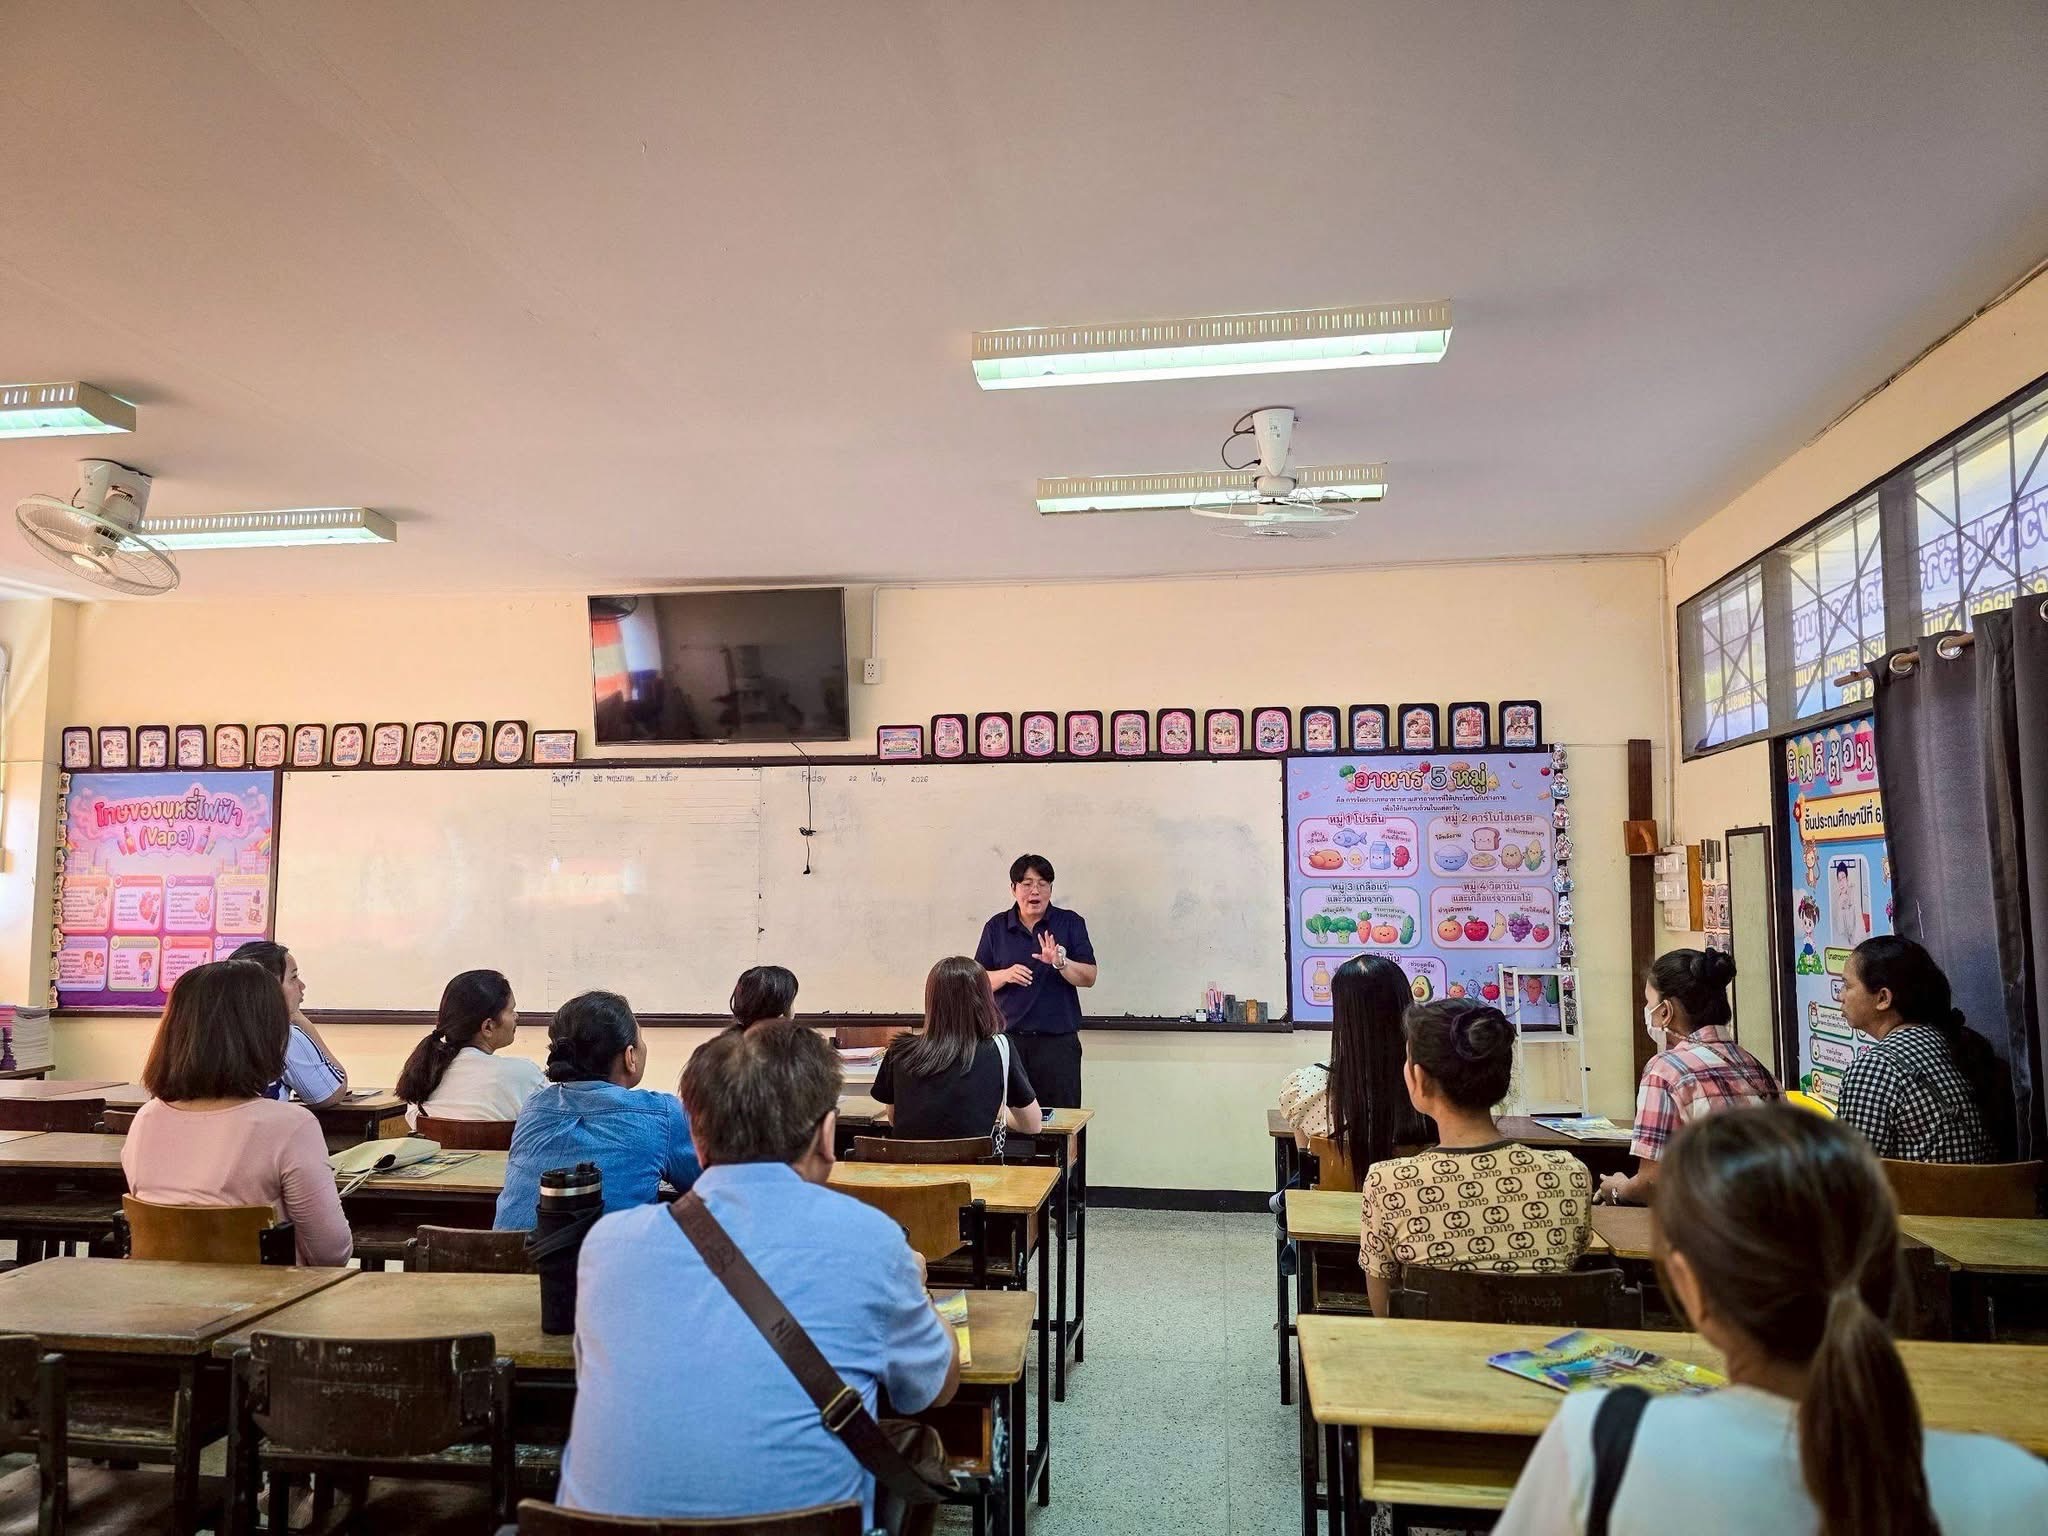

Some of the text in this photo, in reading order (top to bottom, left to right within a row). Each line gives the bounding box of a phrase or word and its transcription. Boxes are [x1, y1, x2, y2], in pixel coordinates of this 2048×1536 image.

[870, 771, 887, 785] May
[911, 775, 929, 783] 2026
[1354, 761, 1488, 794] อาหาร 5 หมู่
[1329, 812, 1385, 827] หมู่ 1 โปรตีน
[1444, 811, 1533, 826] หมู่ 2 คาร์โบไฮเดรต
[1804, 799, 1873, 831] ชั้นประถมศึกษาปีที่
[139, 825, 195, 851] (Vape)
[1331, 881, 1388, 894] หมู่ 3 เกลือแร่
[1464, 880, 1520, 894] หมู่ 4 วิตามิน
[1394, 1178, 1424, 1190] GUCCI
[1432, 1174, 1465, 1184] GUCCI
[1472, 1169, 1502, 1180] GUCCI
[1509, 1164, 1542, 1175] GUCCI
[1419, 1202, 1450, 1214] GUCCI
[1458, 1197, 1489, 1209] GUCCI
[1496, 1193, 1528, 1204] GUCCI
[1536, 1189, 1565, 1199] GUCCI
[1406, 1233, 1435, 1244] GUCCI
[1443, 1228, 1475, 1240] GUCCI
[1483, 1223, 1515, 1235] GUCCI
[1523, 1219, 1554, 1230] GUCCI
[1508, 1248, 1540, 1259] GUCCI
